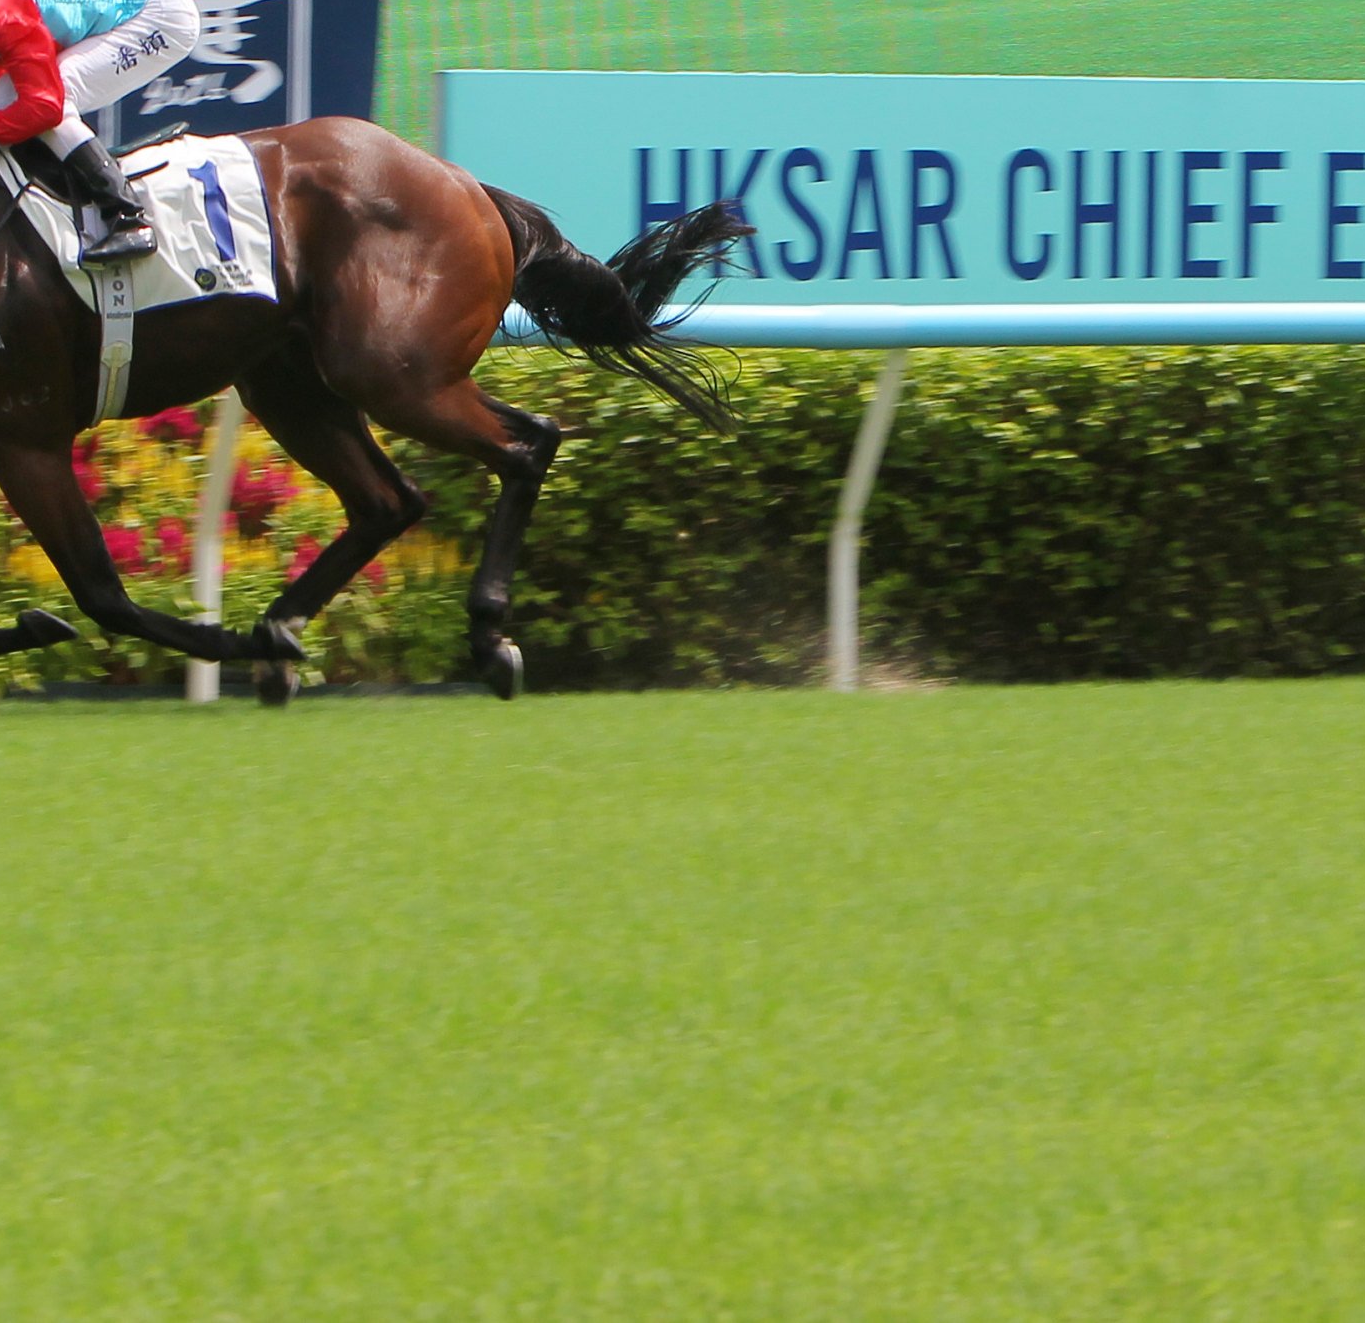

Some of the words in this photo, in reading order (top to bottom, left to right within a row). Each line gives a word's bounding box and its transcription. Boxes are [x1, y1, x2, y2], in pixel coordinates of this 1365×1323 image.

[187, 160, 237, 262] 1
[633, 147, 965, 281] HKSAR
[1002, 148, 1288, 281] CHIEF
